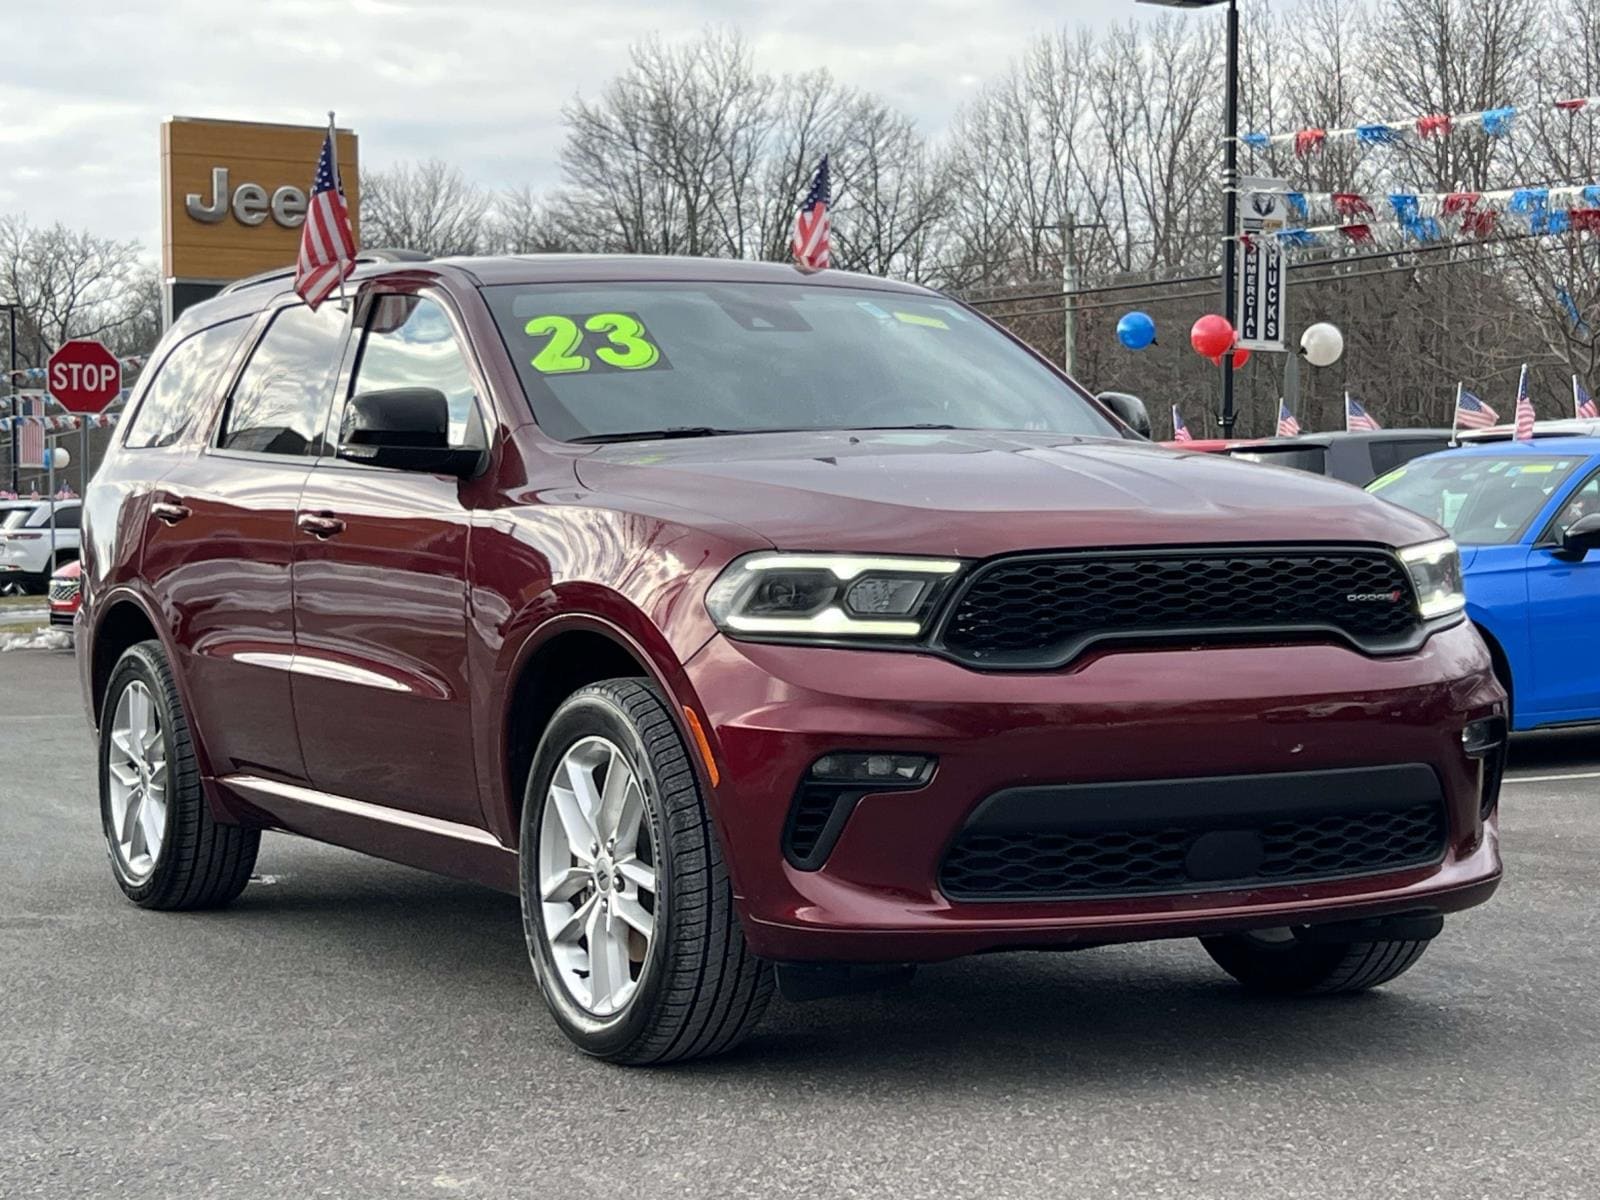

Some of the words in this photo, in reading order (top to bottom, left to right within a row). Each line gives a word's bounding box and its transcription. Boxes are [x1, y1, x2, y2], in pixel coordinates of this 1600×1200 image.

[186, 167, 313, 228] Jee
[1245, 243, 1257, 338] MMERCIAL
[1266, 246, 1278, 337] RUCKS
[524, 312, 660, 375] 23
[52, 362, 117, 392] STOP
